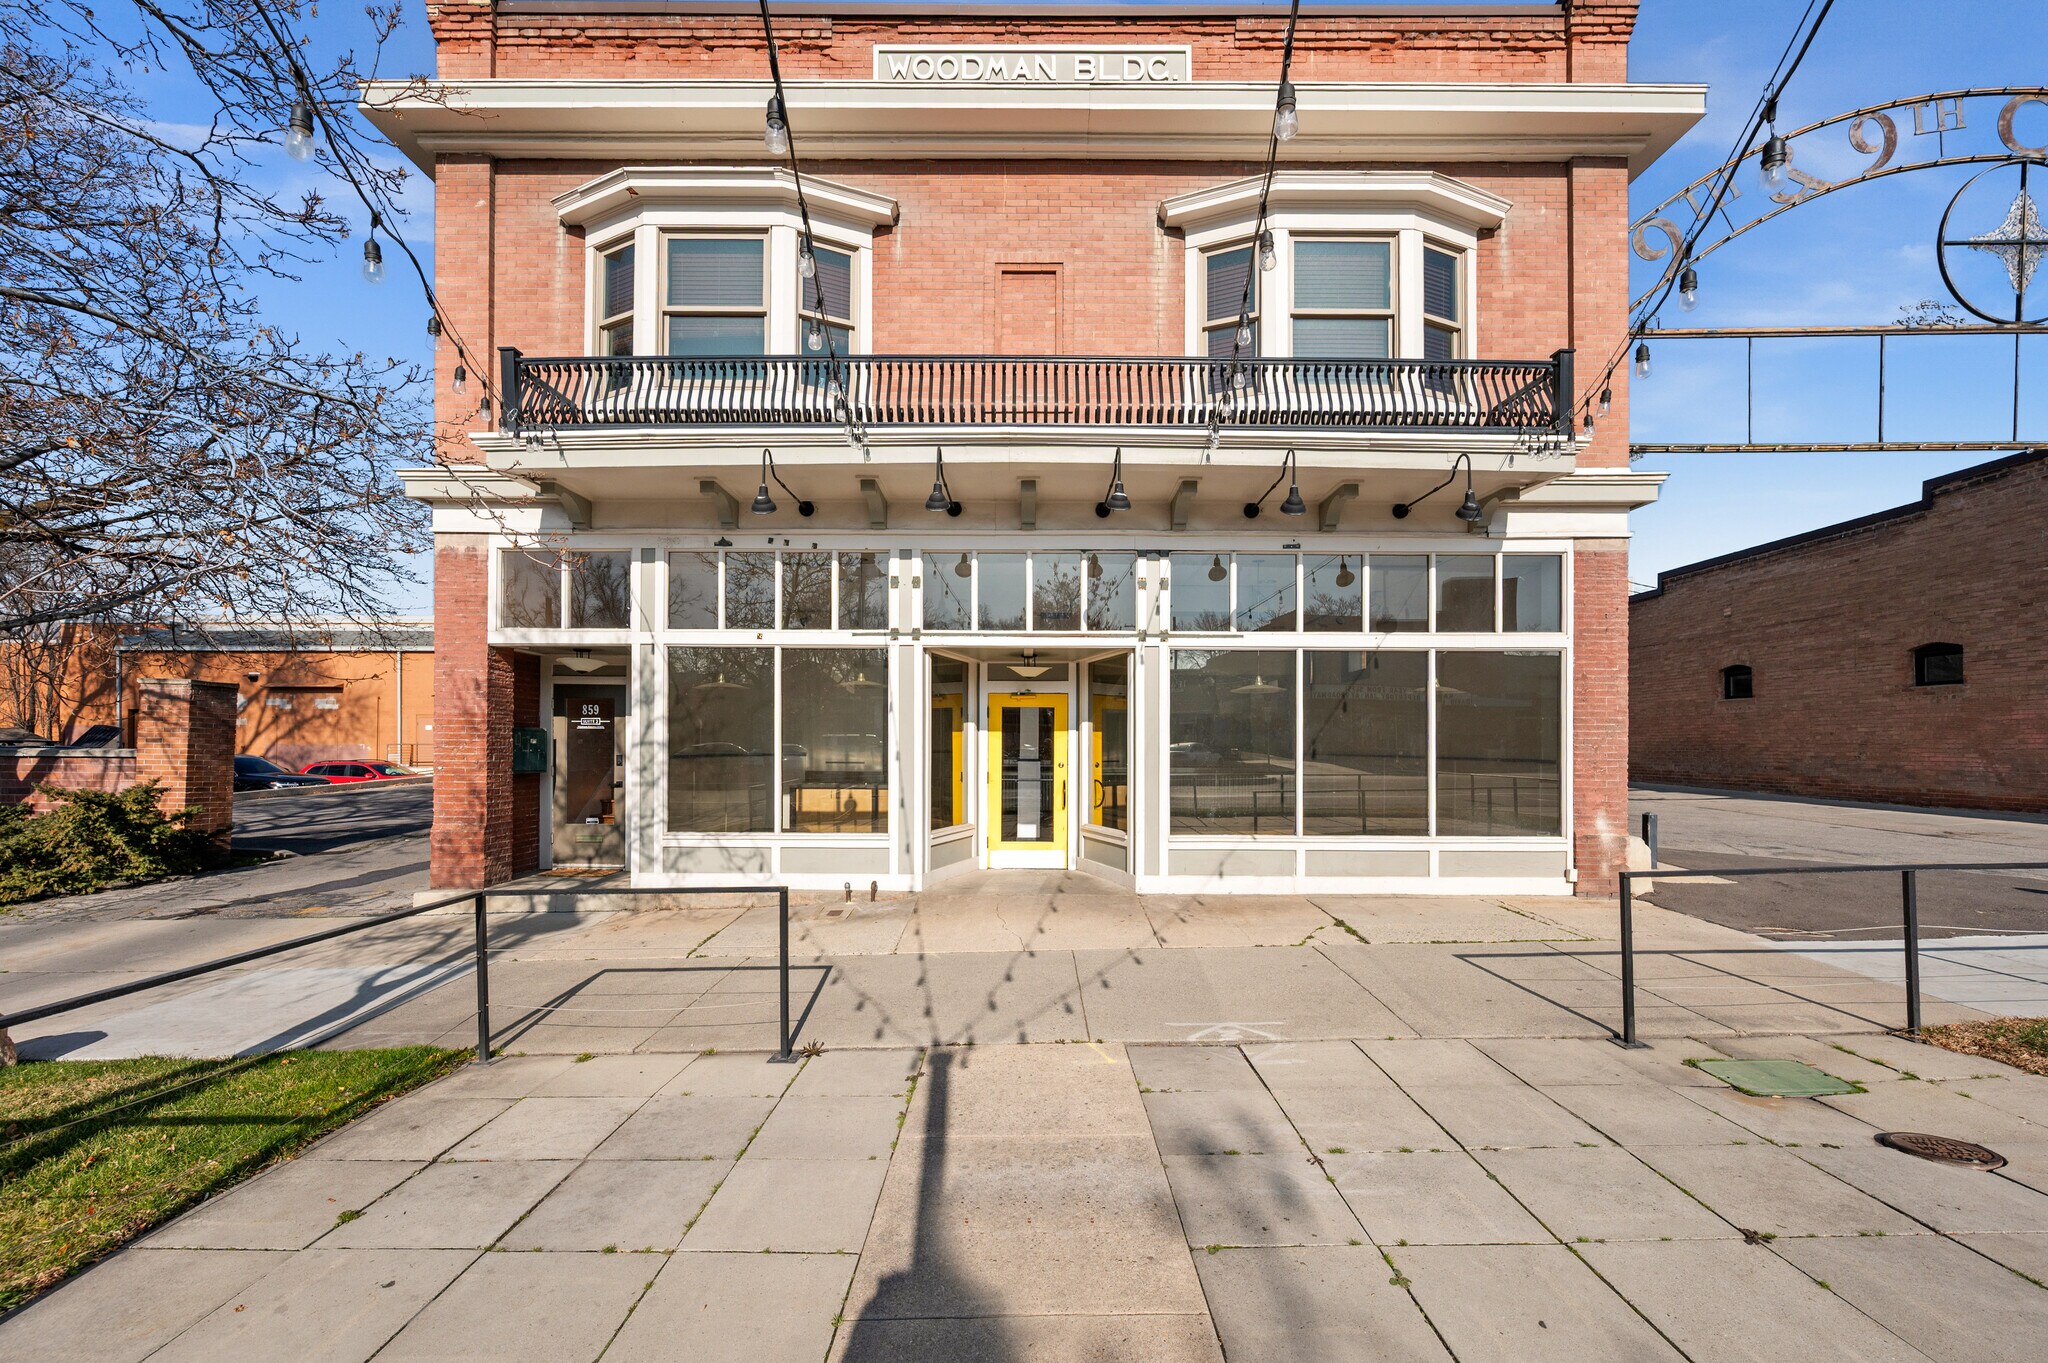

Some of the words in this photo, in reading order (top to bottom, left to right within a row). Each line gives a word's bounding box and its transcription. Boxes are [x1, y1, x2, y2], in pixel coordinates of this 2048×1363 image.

[888, 54, 1057, 81] WOODMAN
[1073, 54, 1179, 81] BLDG.
[1848, 96, 1967, 175] 9TH
[582, 704, 599, 715] 859
